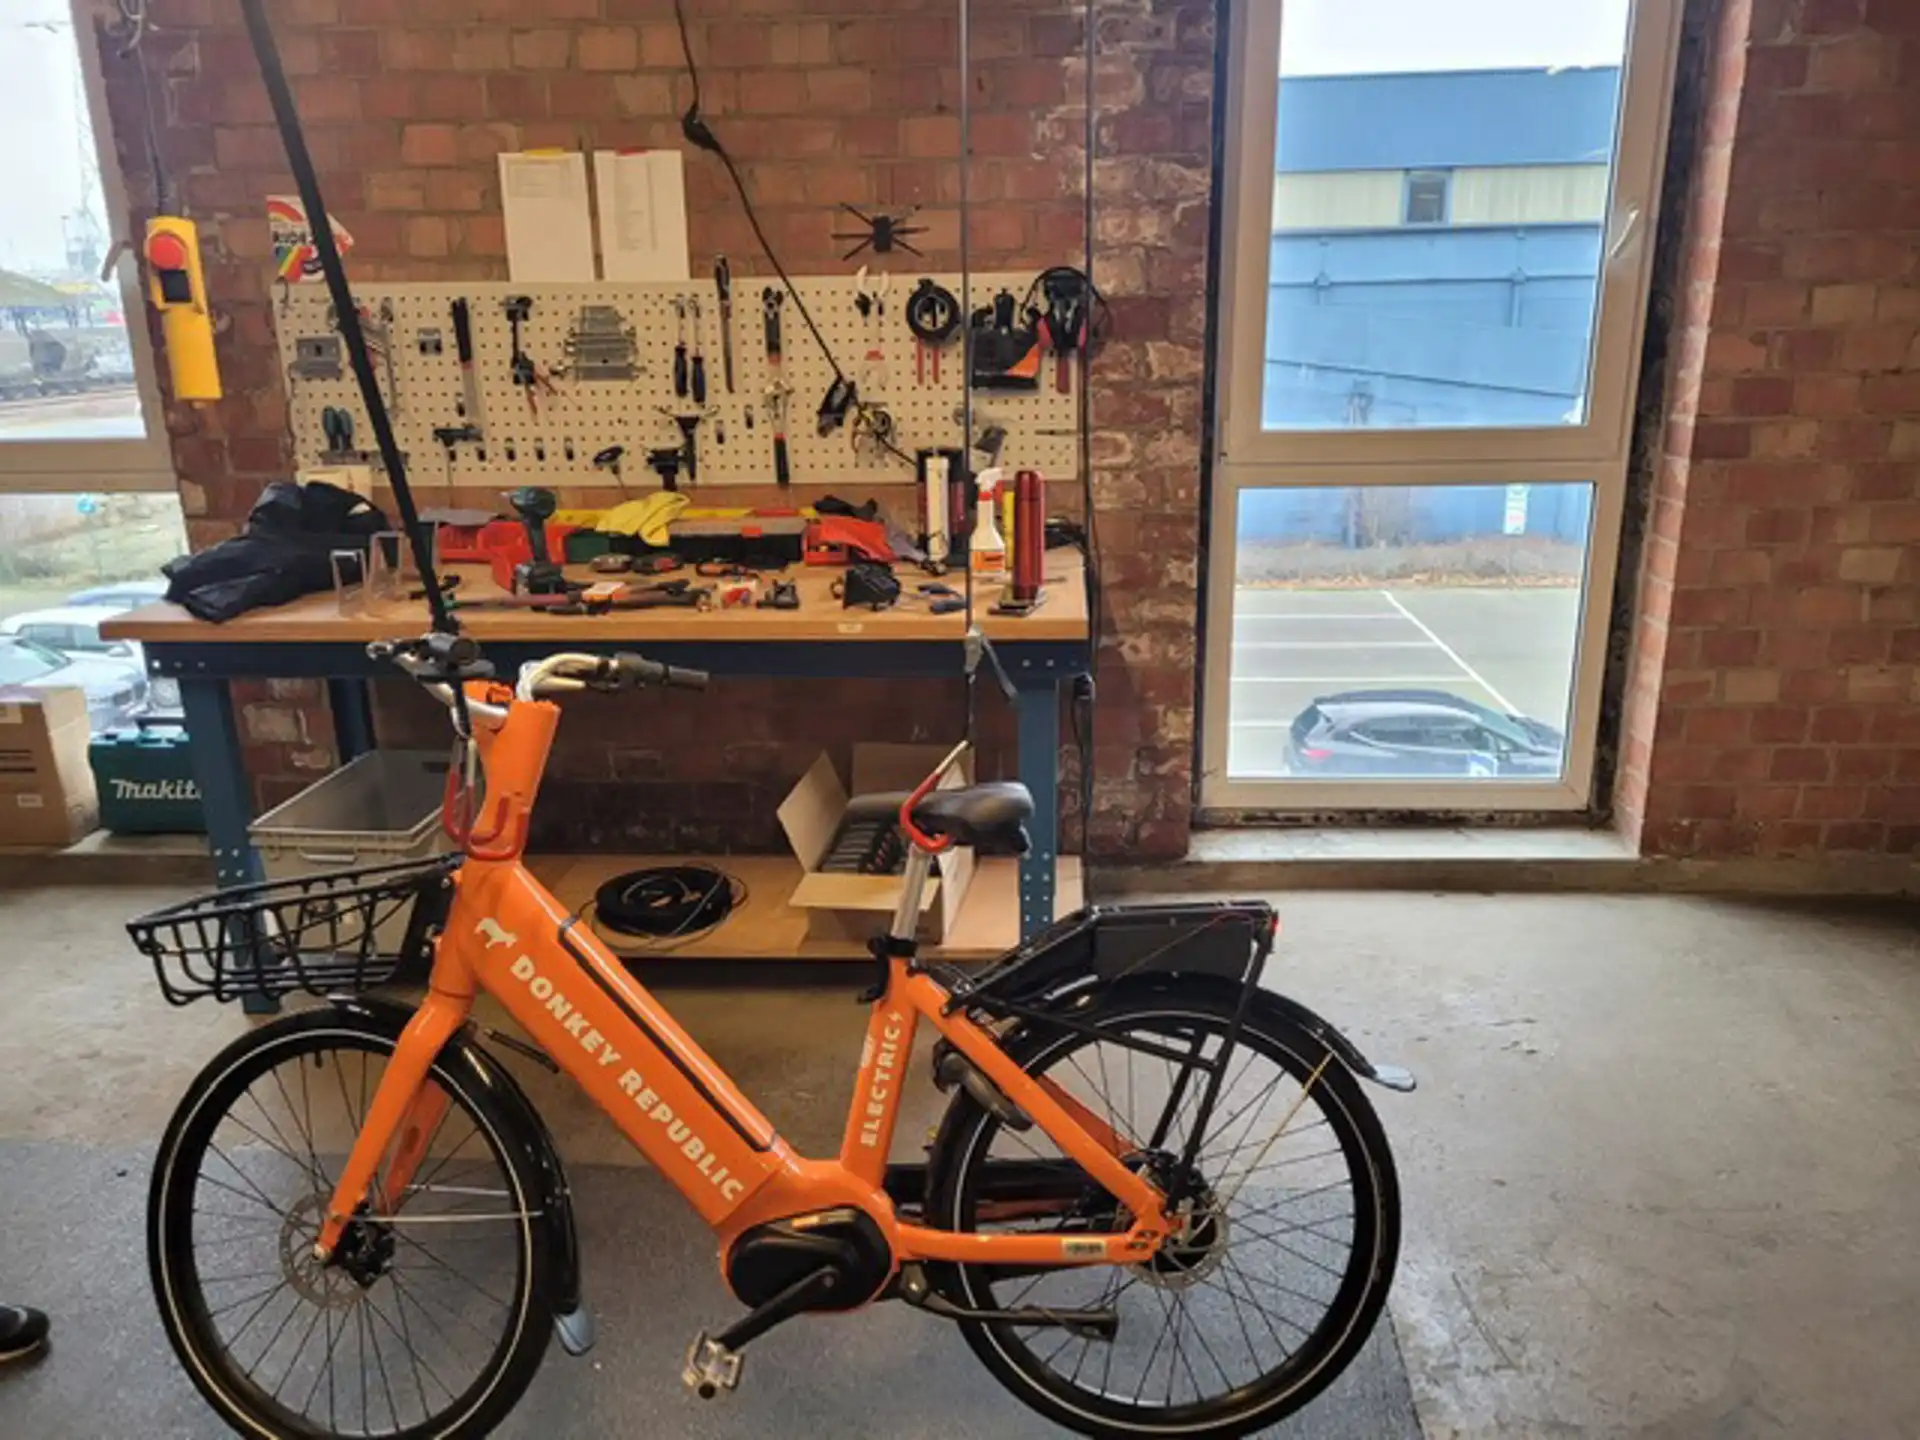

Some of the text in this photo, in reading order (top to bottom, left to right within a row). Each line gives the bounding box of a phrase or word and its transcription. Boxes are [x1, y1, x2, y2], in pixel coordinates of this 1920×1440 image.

[510, 955, 744, 1201] DONKEY REPUBLIC
[861, 1026, 901, 1147] ELECTRIC
